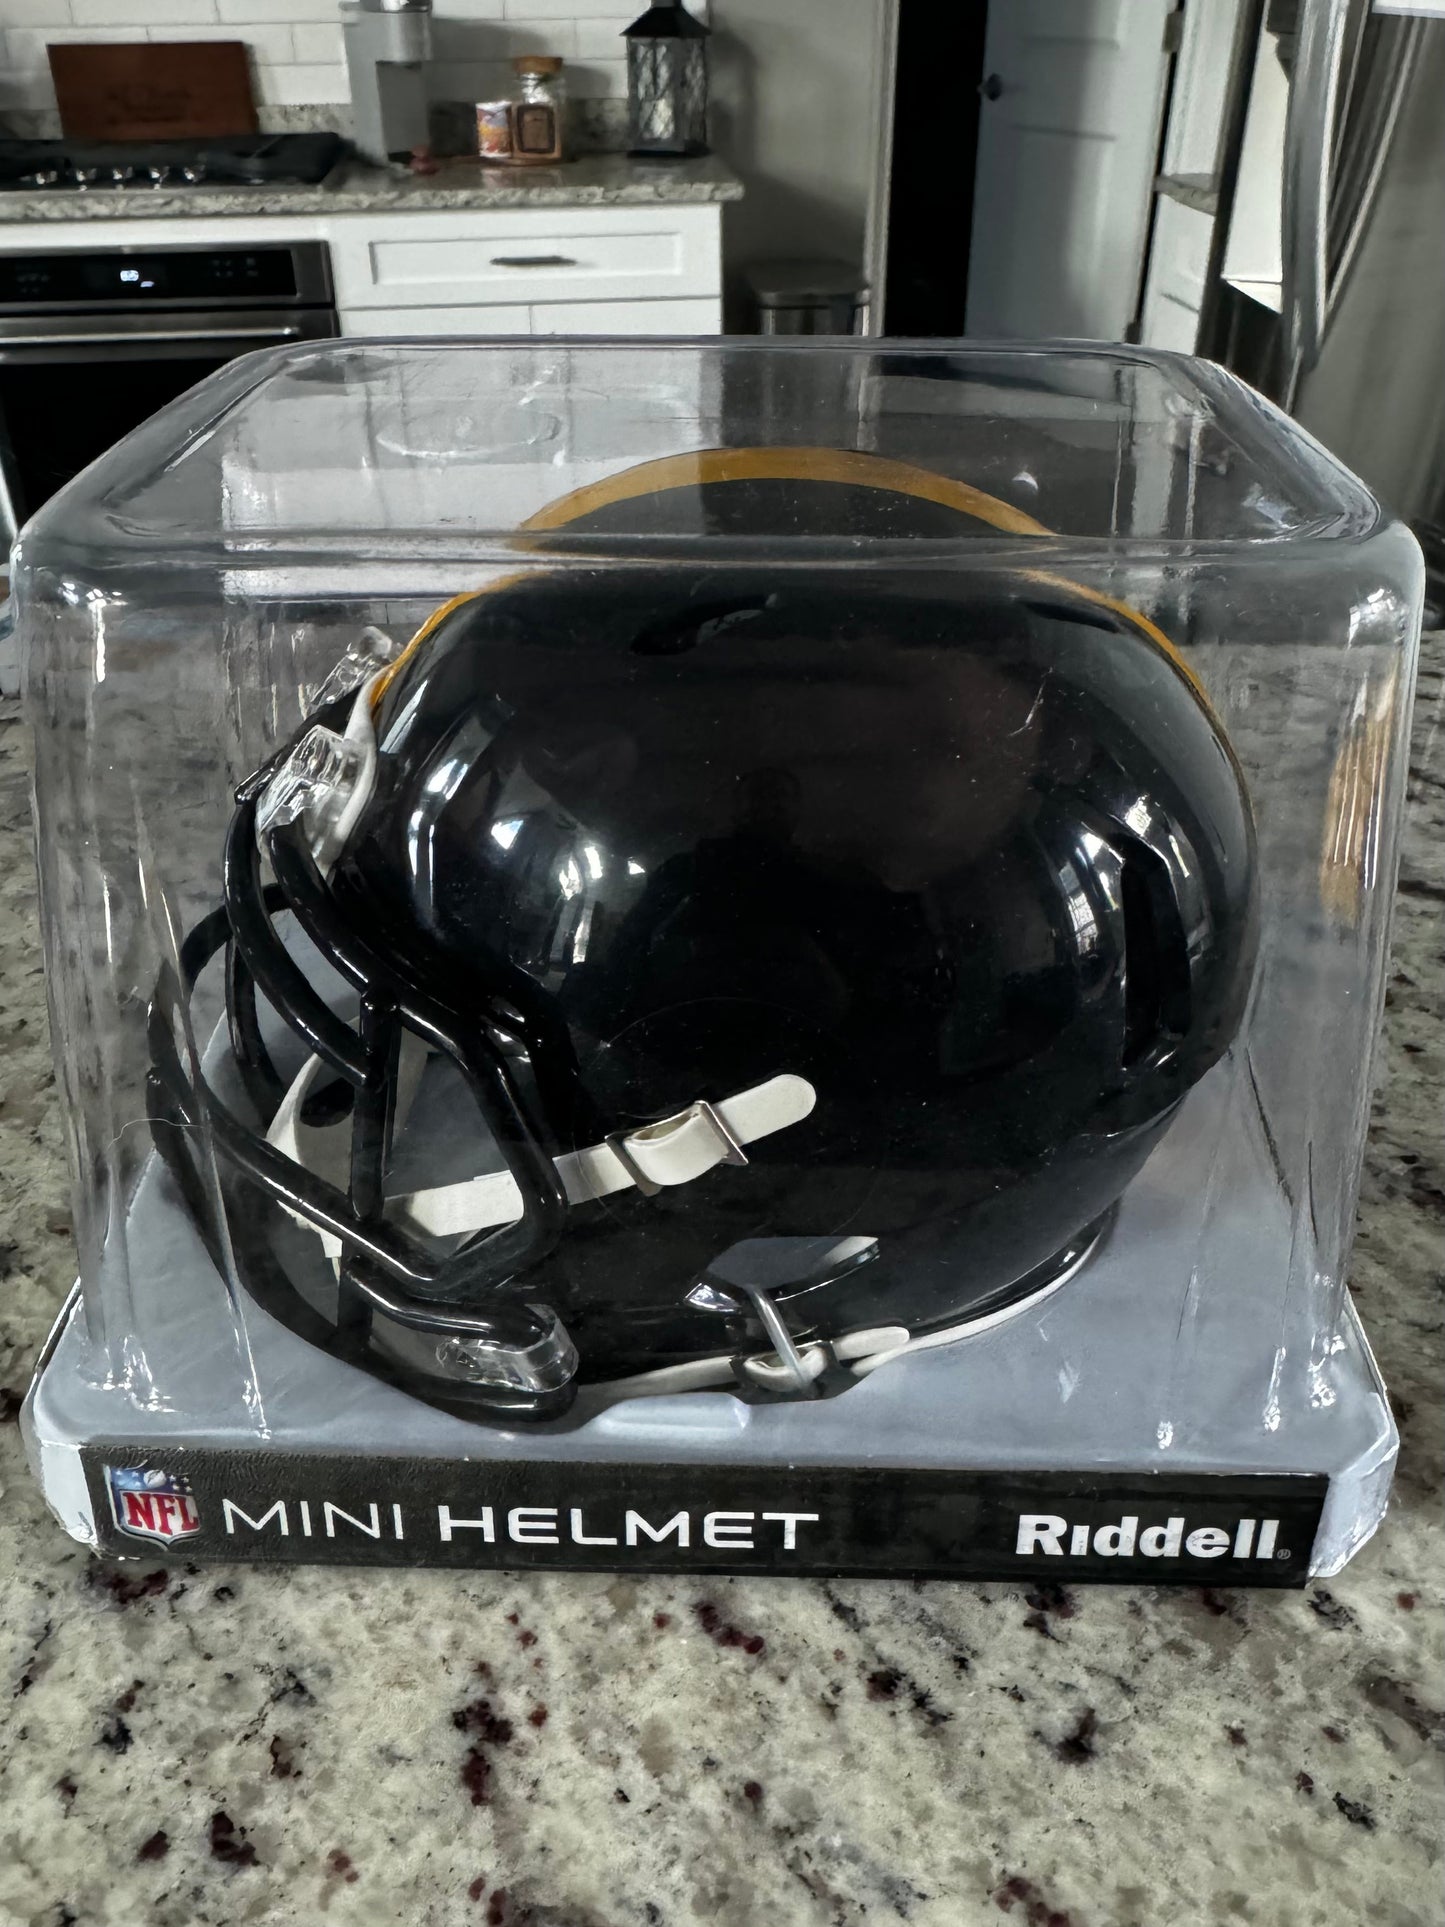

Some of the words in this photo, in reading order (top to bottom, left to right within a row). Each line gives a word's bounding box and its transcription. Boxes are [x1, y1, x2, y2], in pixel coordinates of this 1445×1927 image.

[122, 1492, 199, 1535] NFL
[221, 1498, 404, 1540] MINI
[437, 1505, 820, 1550] HELMET
